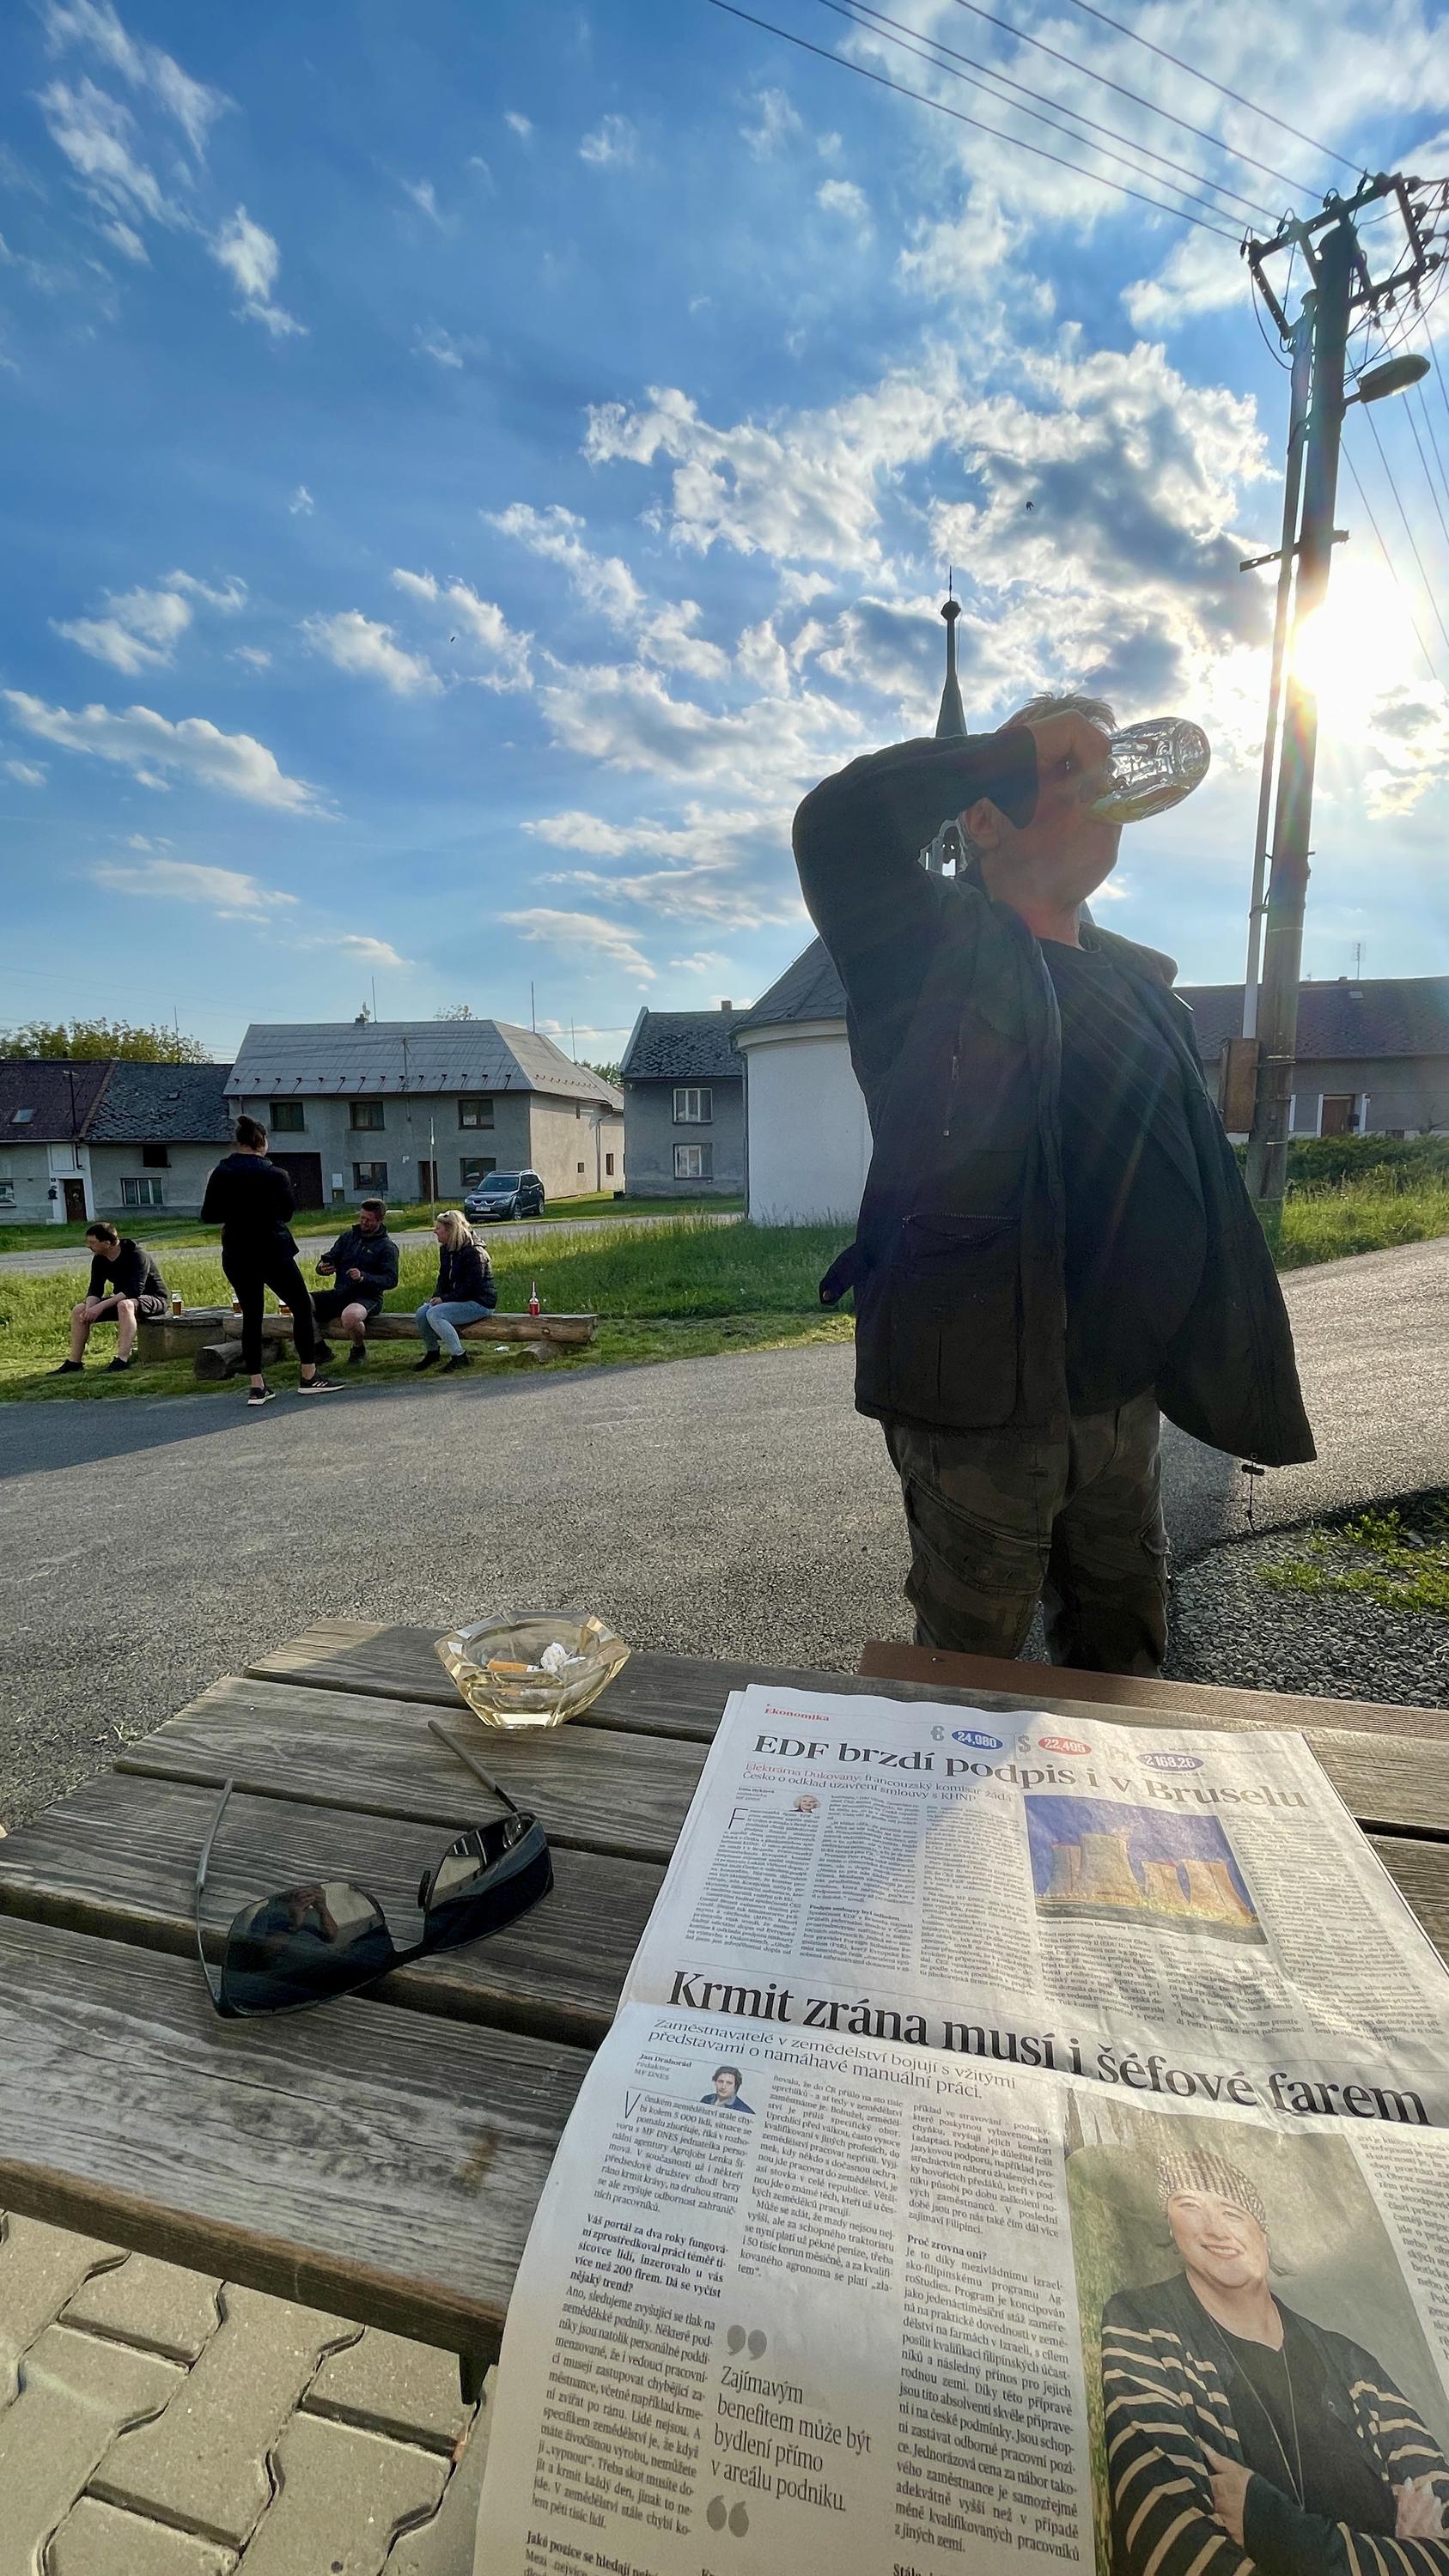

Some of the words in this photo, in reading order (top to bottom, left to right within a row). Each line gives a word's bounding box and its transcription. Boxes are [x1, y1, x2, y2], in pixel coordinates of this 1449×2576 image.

[764, 1708, 830, 1722] Ekonomika
[752, 1735, 829, 1759] EDF
[838, 1742, 935, 1771] brzdí
[945, 1758, 1076, 1789] podpis
[1087, 1767, 1100, 1788] i
[1108, 1776, 1132, 1792] v
[1144, 1778, 1309, 1807] Bruselu
[788, 1777, 826, 1788] odklad
[880, 1784, 928, 1799] smlouvy
[941, 1792, 977, 1802] KHNP
[639, 2053, 653, 2063] Jan
[648, 2032, 746, 2055] představami
[749, 2047, 760, 2057] o
[764, 2047, 848, 2073] namáhavé
[852, 2063, 930, 2089] manuální
[935, 2079, 982, 2099] práci.
[654, 2019, 774, 2044] Zaměstnavatelé
[778, 2037, 788, 2045] v
[791, 2039, 886, 2063] zemědělství
[892, 2053, 936, 2074] bojují
[941, 2065, 950, 2075] s
[954, 2066, 1016, 2089] vžitými
[667, 1970, 795, 2023] Krmit
[802, 1998, 929, 2046] zrána
[941, 2020, 1057, 2070] musí
[1068, 2038, 1085, 2076] i
[1097, 2043, 1257, 2106] šéfové
[1266, 2072, 1434, 2126] farem
[588, 2212, 602, 2224] Váš
[604, 2219, 631, 2232] portál
[645, 2226, 663, 2239] dva
[664, 2233, 686, 2247] roky
[592, 2232, 661, 2252] zprostředkoval
[661, 2246, 685, 2258] práci
[686, 2251, 715, 2264] téměř
[570, 2269, 601, 2287] nějaký
[602, 2277, 633, 2292] trend?
[575, 2255, 593, 2267] více
[594, 2261, 612, 2271] než
[612, 2263, 632, 2276] 200
[634, 2268, 663, 2283] firem.
[693, 2284, 721, 2297] vyčíst
[578, 2239, 612, 2256] sícovce
[615, 2247, 635, 2263] lidí,
[641, 2252, 691, 2274] inzerovalo
[708, 2270, 723, 2281] vás
[721, 2365, 804, 2404] Zajímavým
[716, 2393, 794, 2433] benefitem
[798, 2418, 842, 2445] může
[846, 2423, 873, 2455] být
[714, 2422, 772, 2459] bydlení
[776, 2443, 823, 2473] přímo
[711, 2459, 721, 2476] v
[723, 2460, 771, 2492] areálu
[776, 2475, 846, 2512] podniku.
